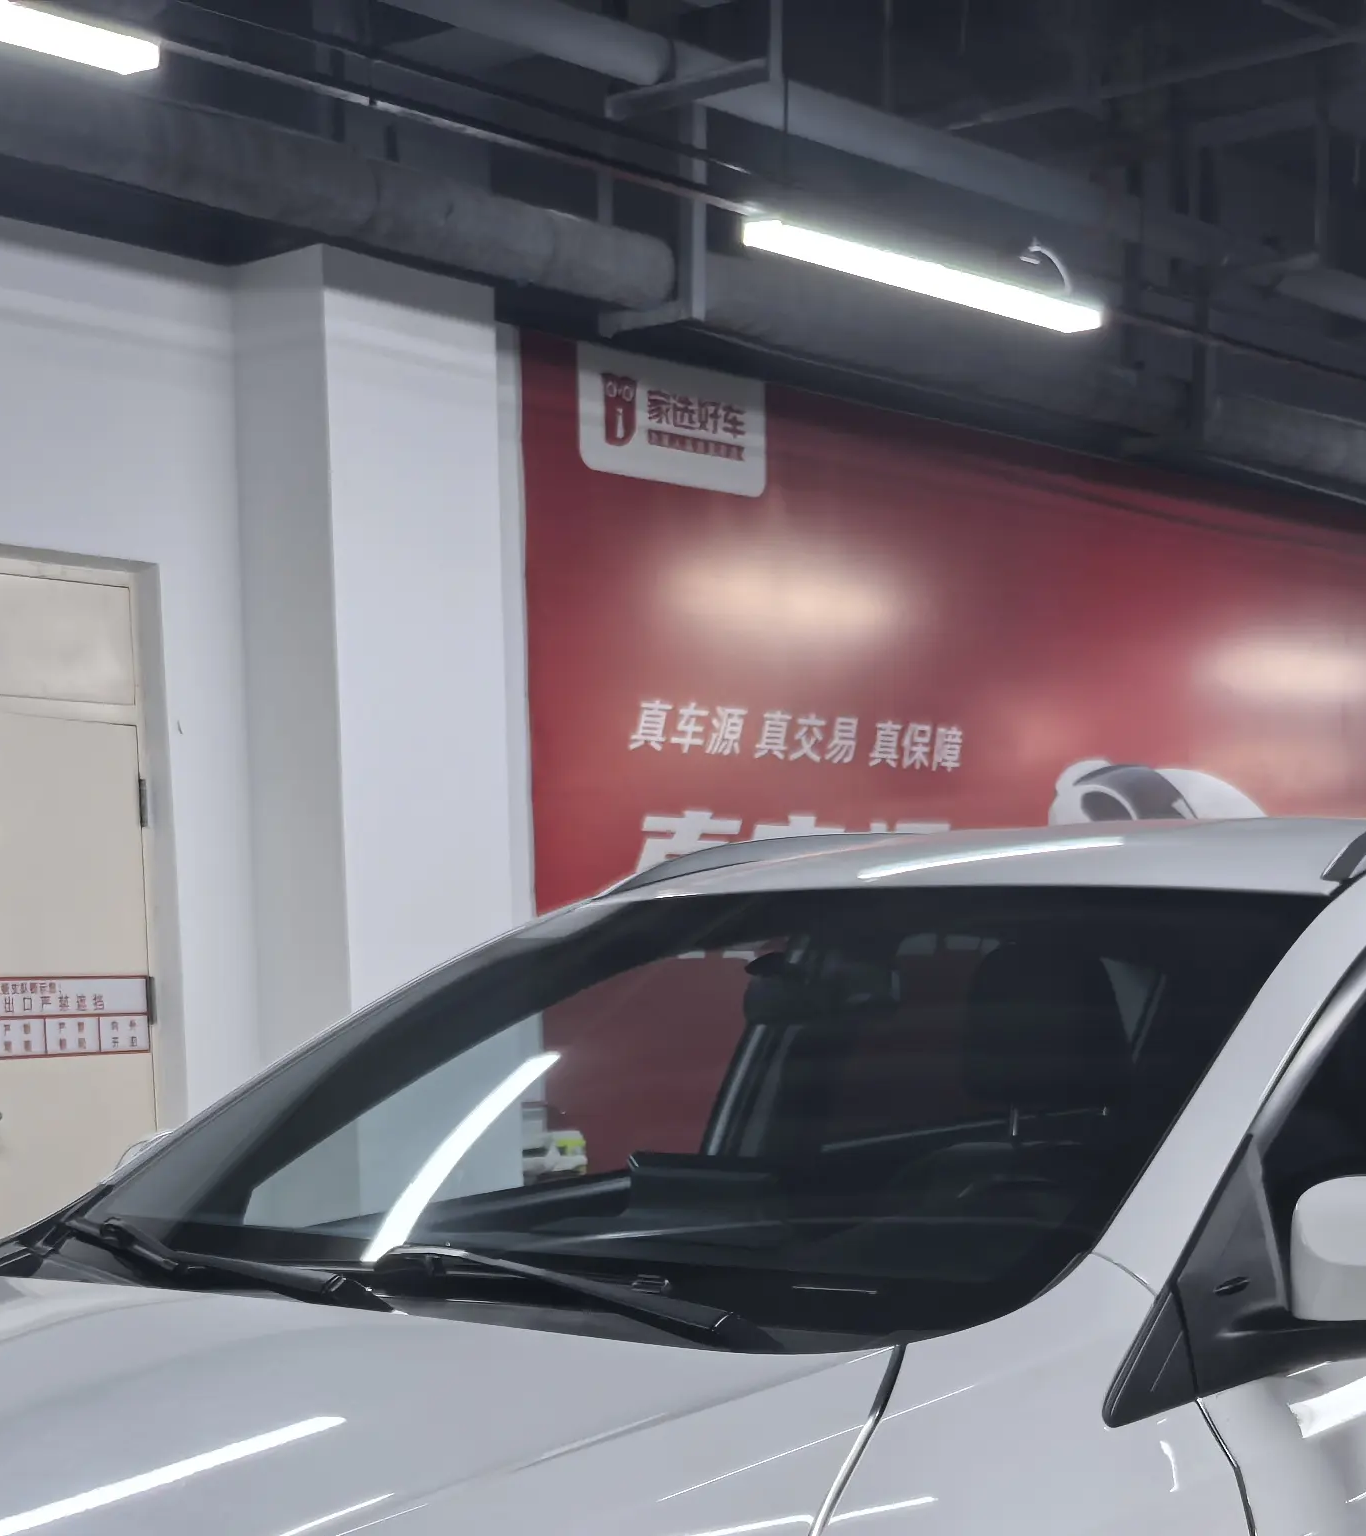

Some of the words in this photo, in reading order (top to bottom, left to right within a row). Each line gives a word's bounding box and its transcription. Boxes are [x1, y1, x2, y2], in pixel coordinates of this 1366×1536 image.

[647, 389, 747, 438] 家选好车
[628, 700, 748, 756] 真车源
[754, 711, 859, 764] 真交易
[868, 721, 963, 772] 真保障
